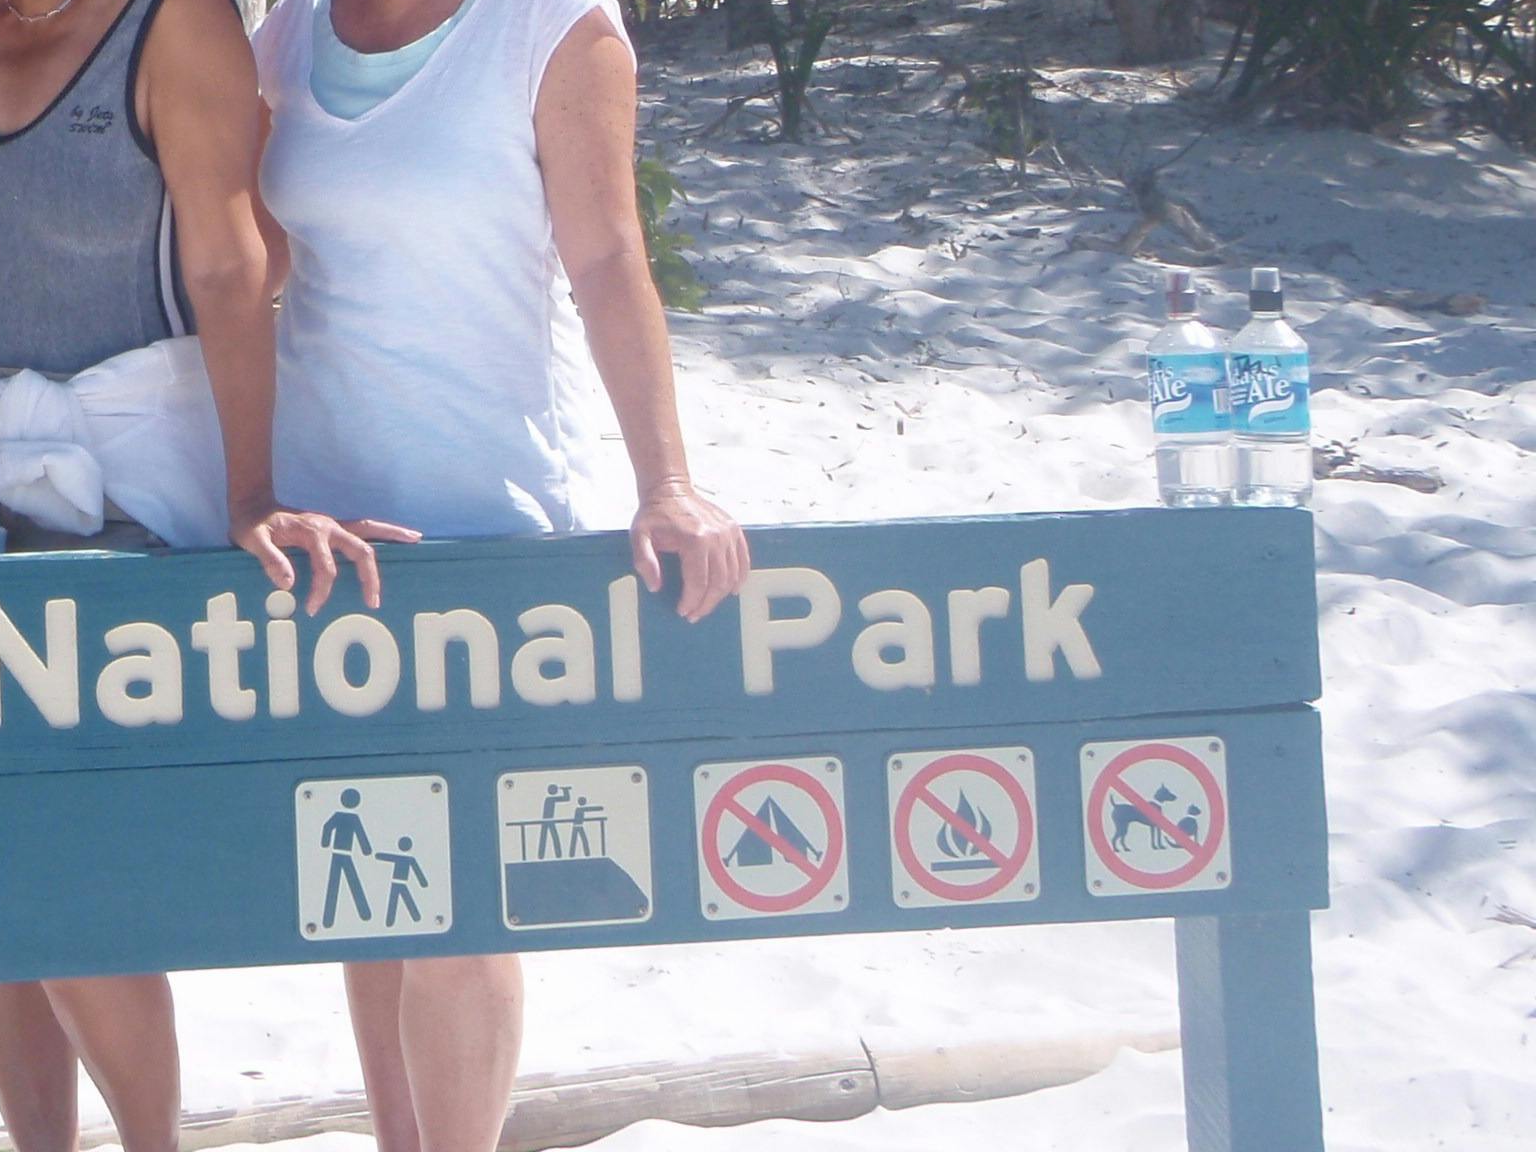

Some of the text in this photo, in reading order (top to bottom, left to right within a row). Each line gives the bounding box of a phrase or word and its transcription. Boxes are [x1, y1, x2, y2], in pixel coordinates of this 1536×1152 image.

[1152, 377, 1187, 404] Ale
[1247, 374, 1291, 404] Ale
[739, 557, 1102, 695] Park
